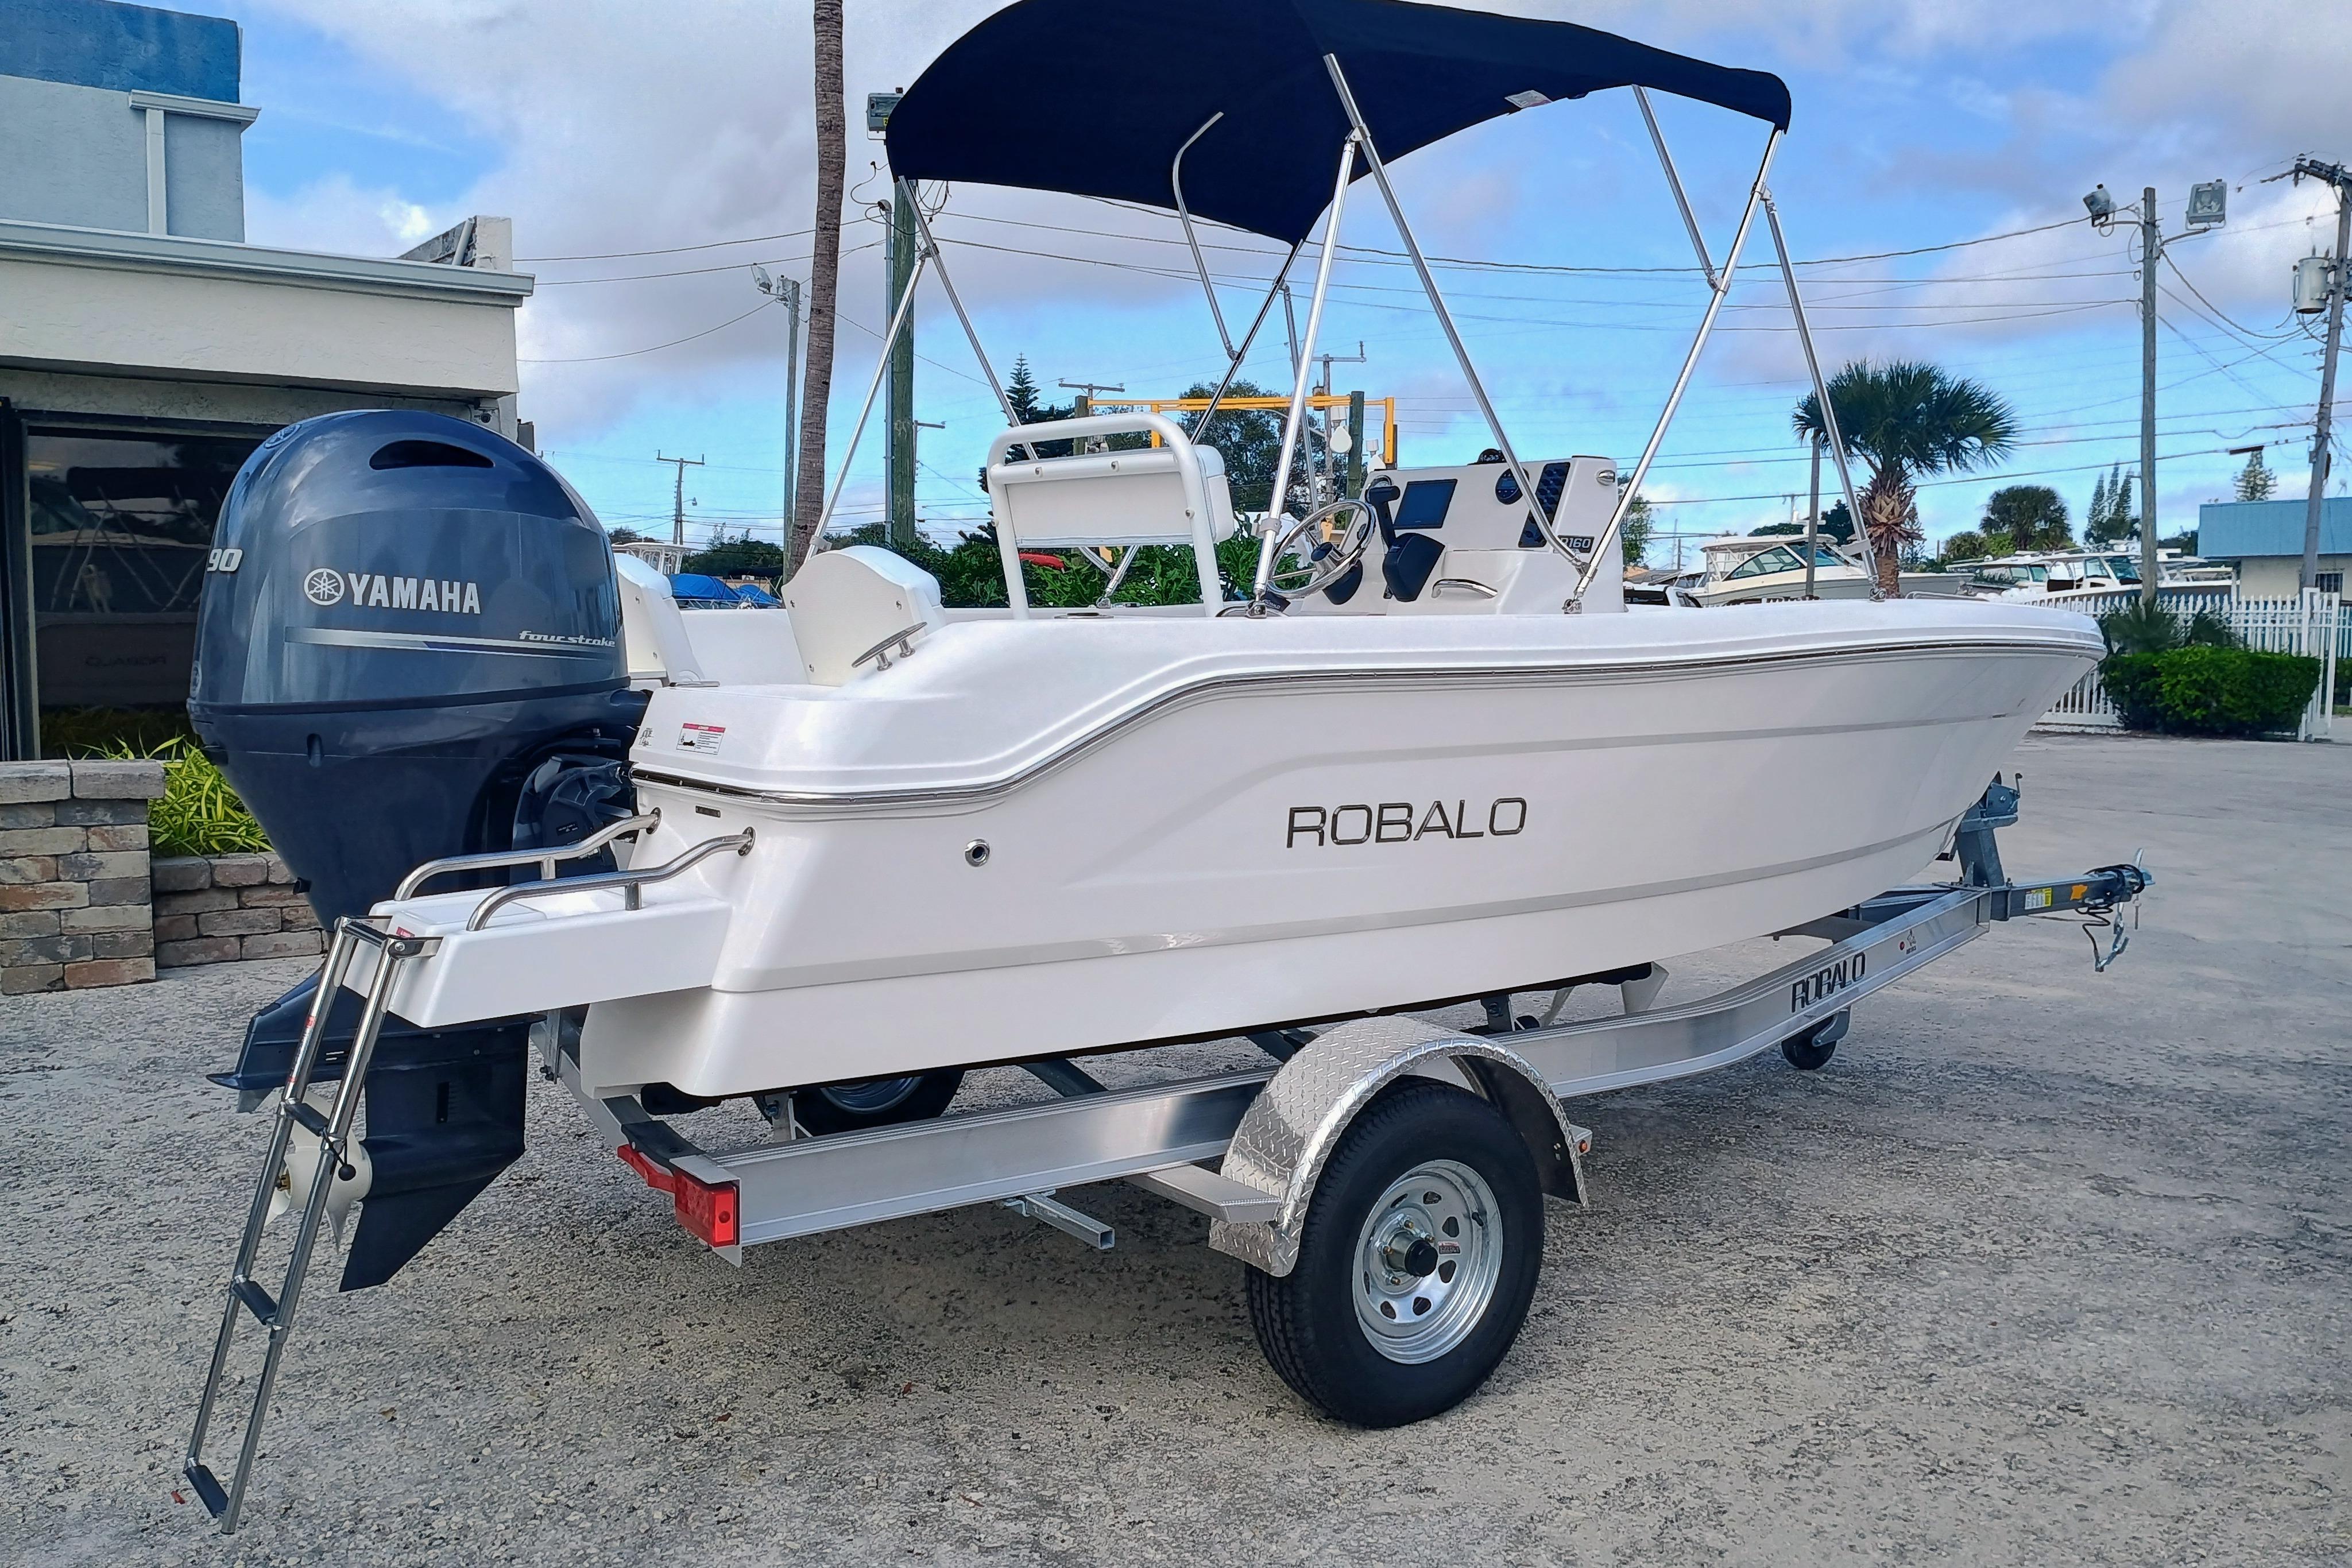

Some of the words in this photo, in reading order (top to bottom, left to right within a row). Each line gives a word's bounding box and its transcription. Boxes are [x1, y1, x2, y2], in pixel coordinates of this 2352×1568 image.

[207, 548, 242, 572] 90
[348, 573, 481, 614] YAMAHA
[1287, 797, 1527, 849] ROBALO
[1791, 952, 1866, 1013] ROBALO
